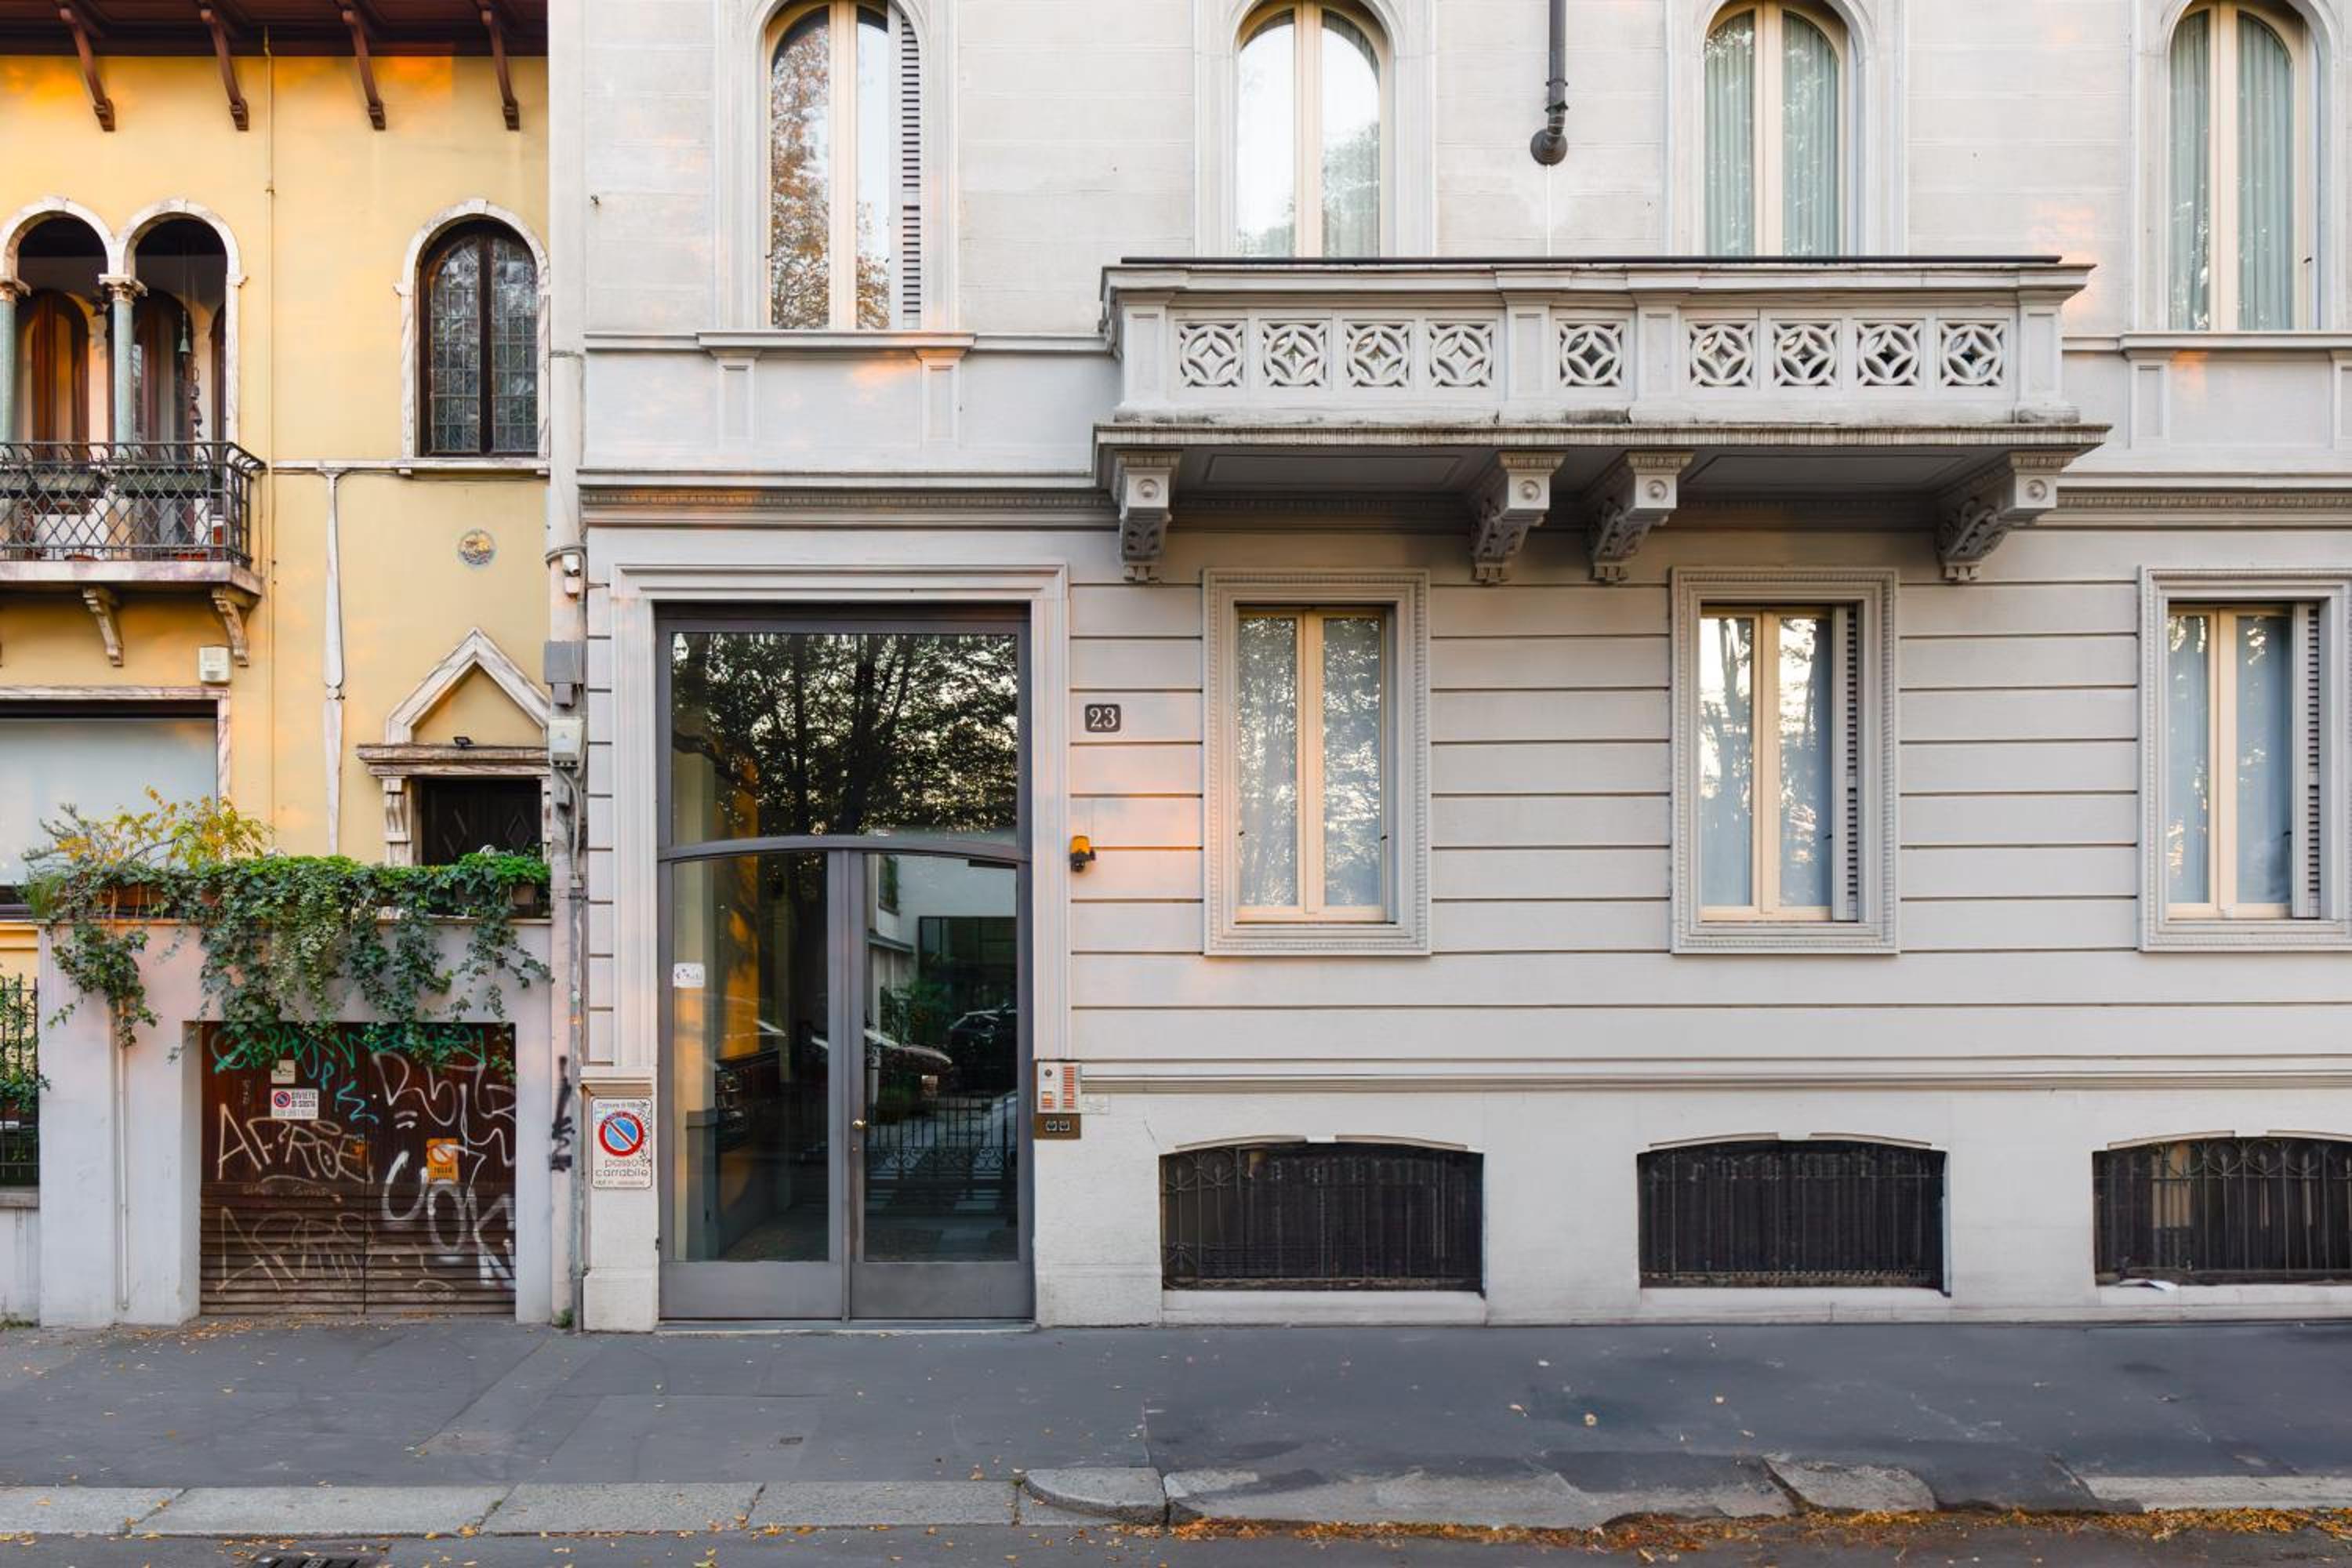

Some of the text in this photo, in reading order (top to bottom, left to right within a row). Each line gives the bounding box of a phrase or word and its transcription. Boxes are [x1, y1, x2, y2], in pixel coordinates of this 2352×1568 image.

[1089, 707, 1117, 728] 23
[604, 1160, 638, 1168] passo
[595, 1168, 648, 1177] carrabile
